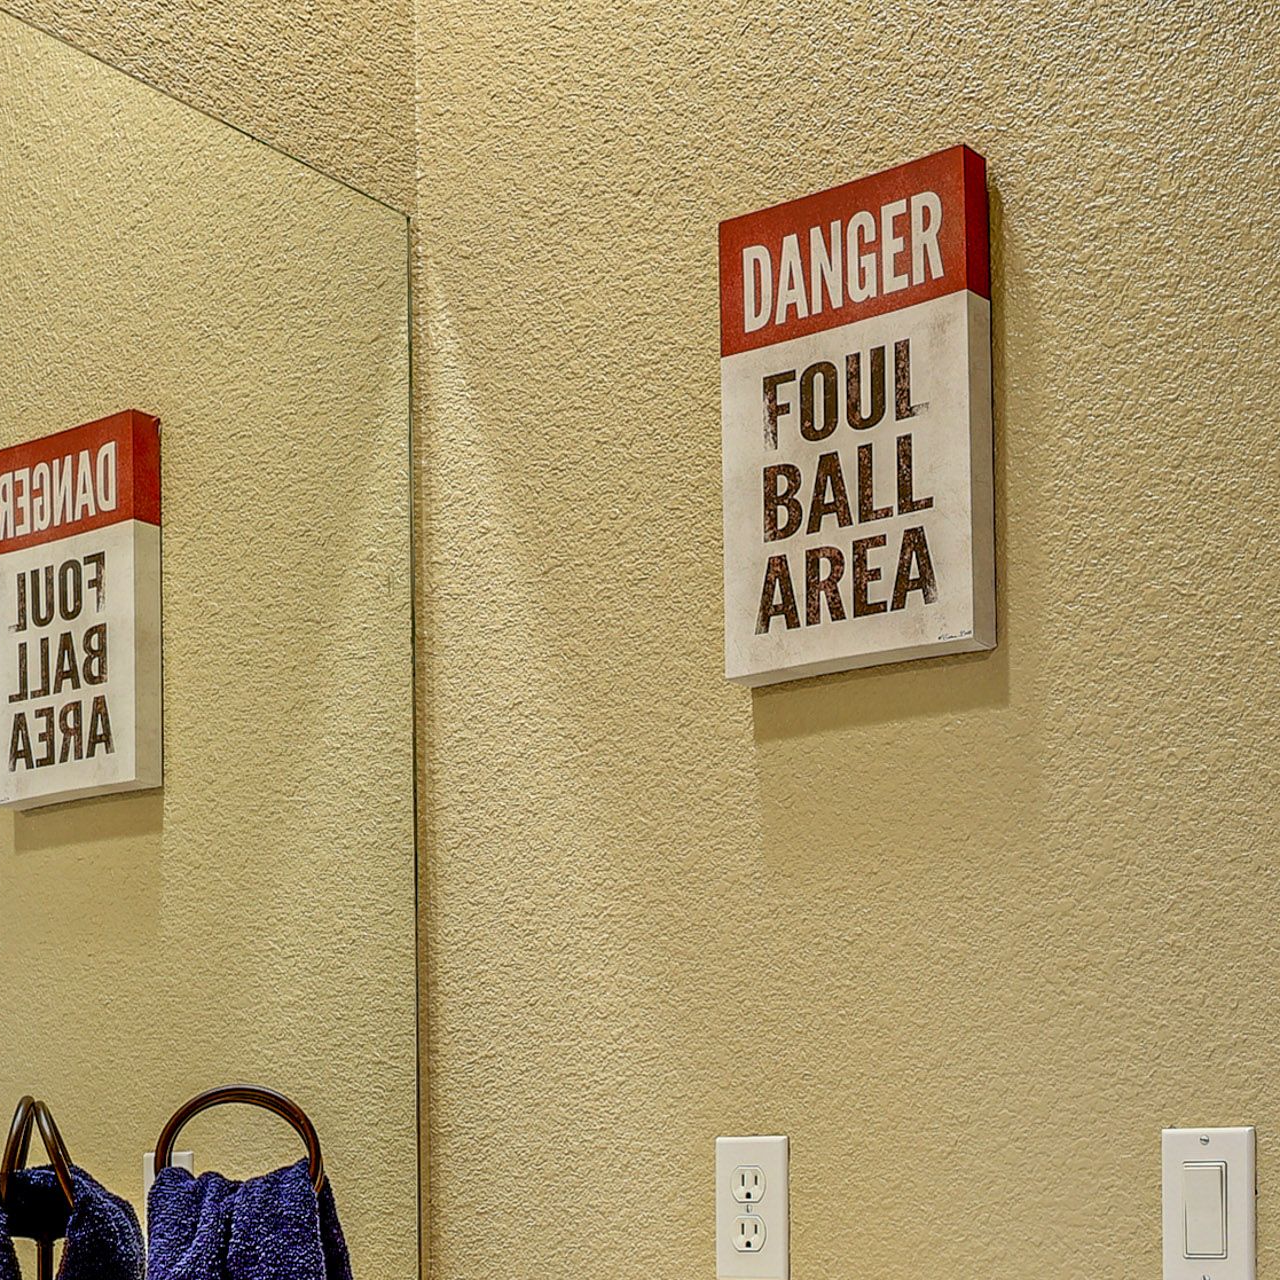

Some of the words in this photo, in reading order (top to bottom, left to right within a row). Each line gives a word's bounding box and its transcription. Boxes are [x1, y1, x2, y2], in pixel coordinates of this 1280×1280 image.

[741, 189, 946, 334] DANGER
[762, 337, 930, 452] FOUL
[762, 432, 934, 544] BALL
[754, 525, 939, 637] AREA
